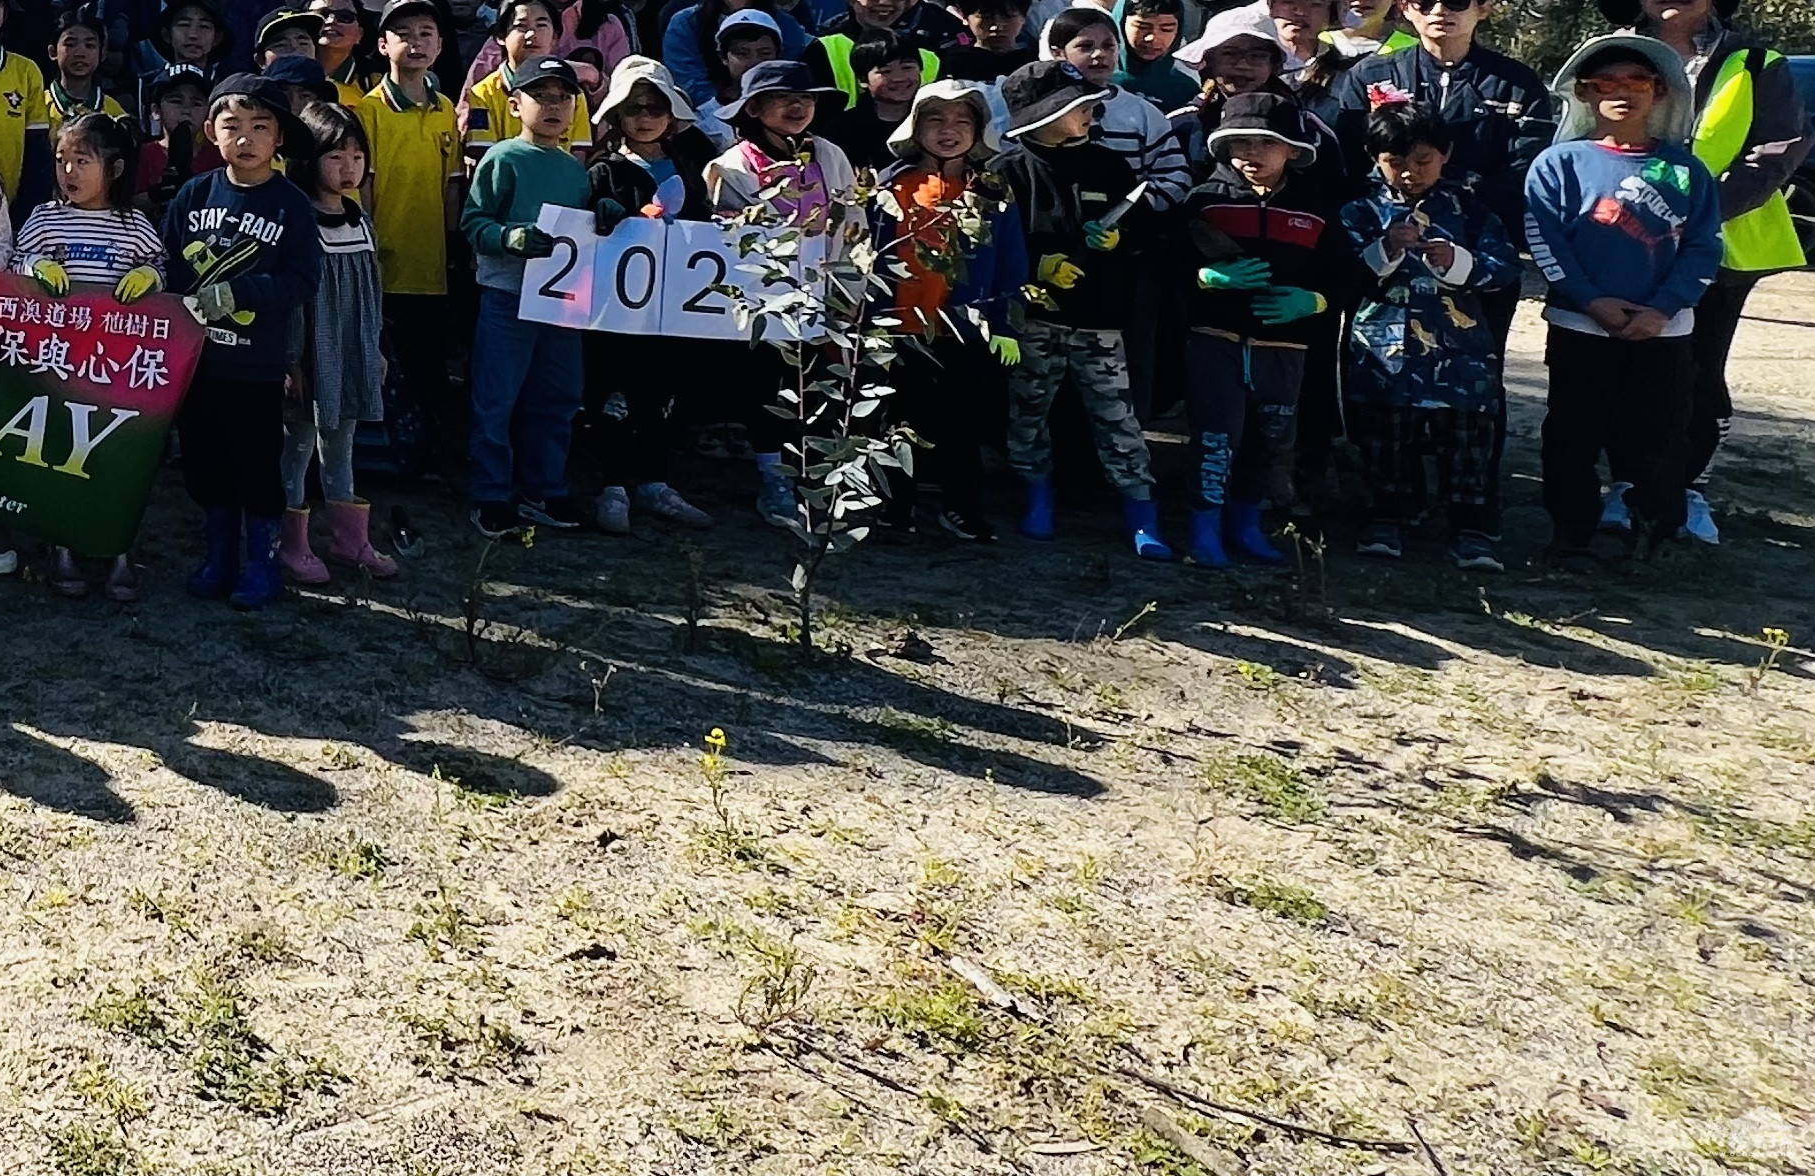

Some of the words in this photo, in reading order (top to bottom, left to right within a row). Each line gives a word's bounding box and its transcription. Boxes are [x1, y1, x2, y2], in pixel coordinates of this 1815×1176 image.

[188, 208, 228, 232] STAY
[238, 212, 284, 246] RAD!
[538, 235, 728, 315] 202
